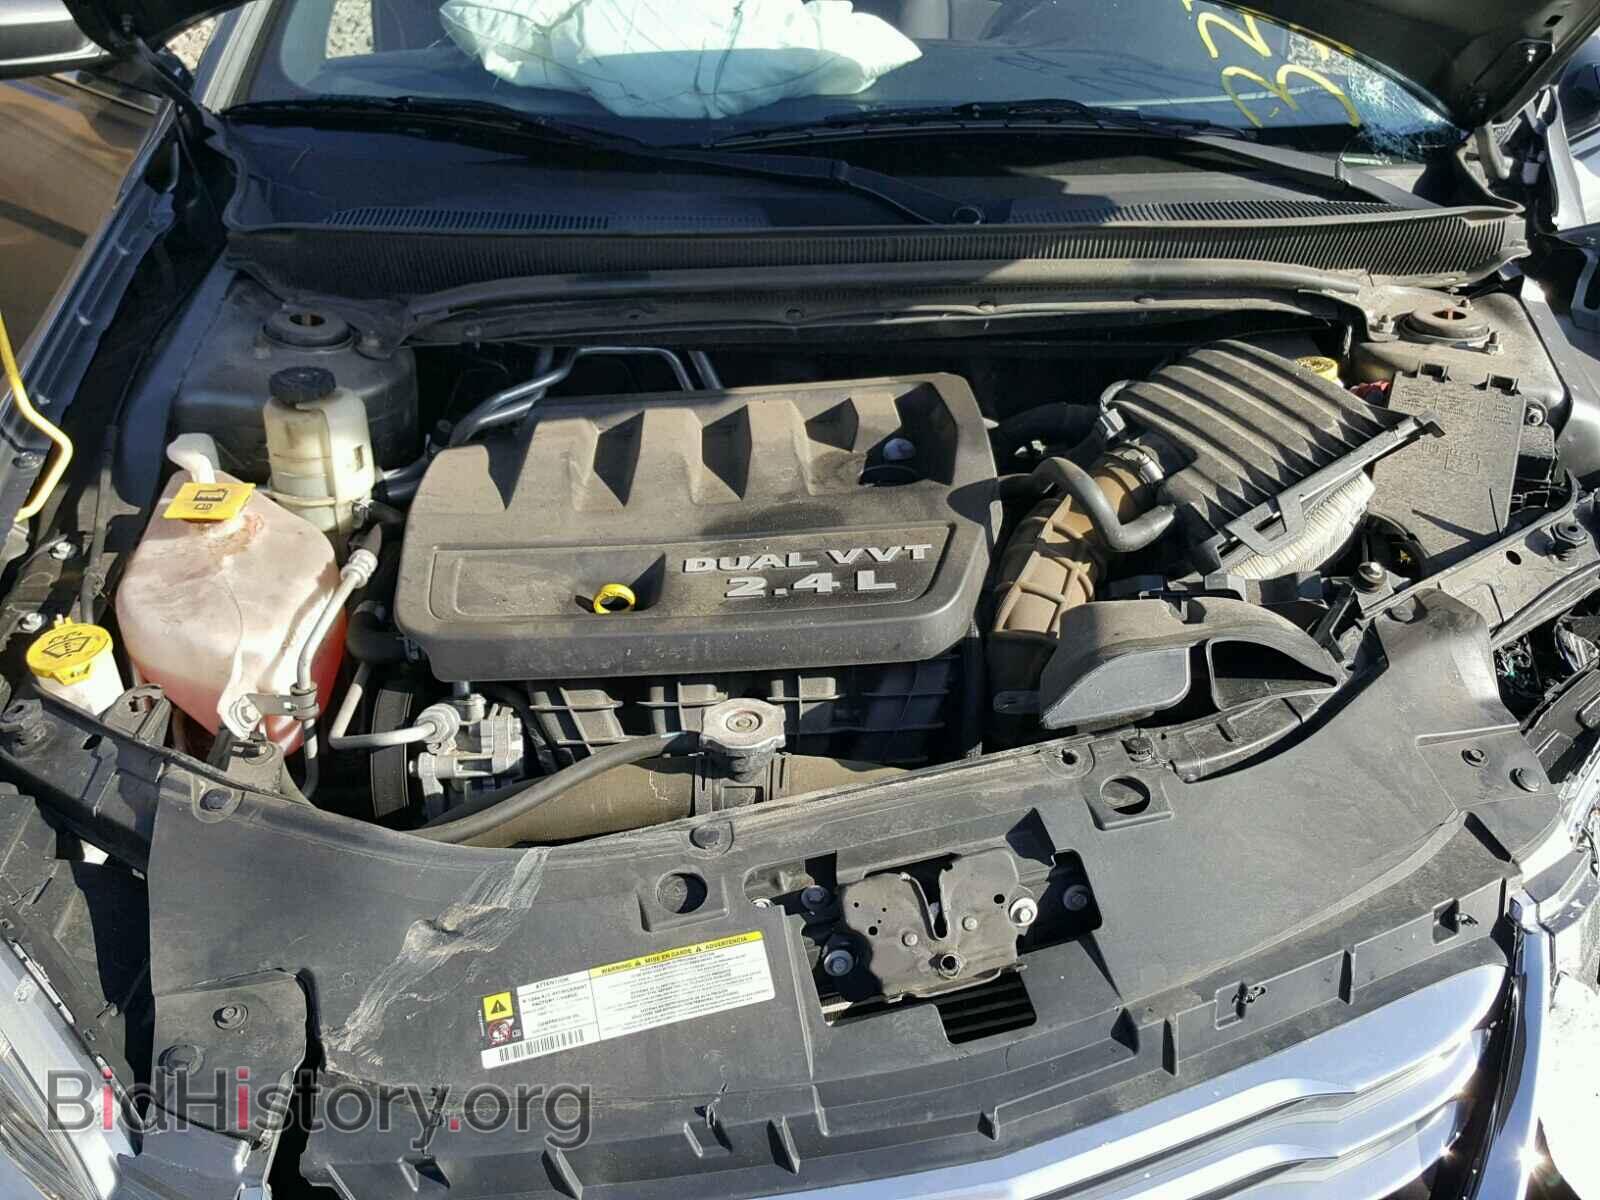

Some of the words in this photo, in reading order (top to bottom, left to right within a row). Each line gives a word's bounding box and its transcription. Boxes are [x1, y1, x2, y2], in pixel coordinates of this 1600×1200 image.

[683, 552, 818, 573] DUAL
[826, 543, 932, 564] VVT
[601, 962, 633, 975] WARNING
[671, 948, 692, 959] GARDE
[705, 936, 748, 950] ADVERTENCIA
[535, 977, 569, 989] ATTENTION
